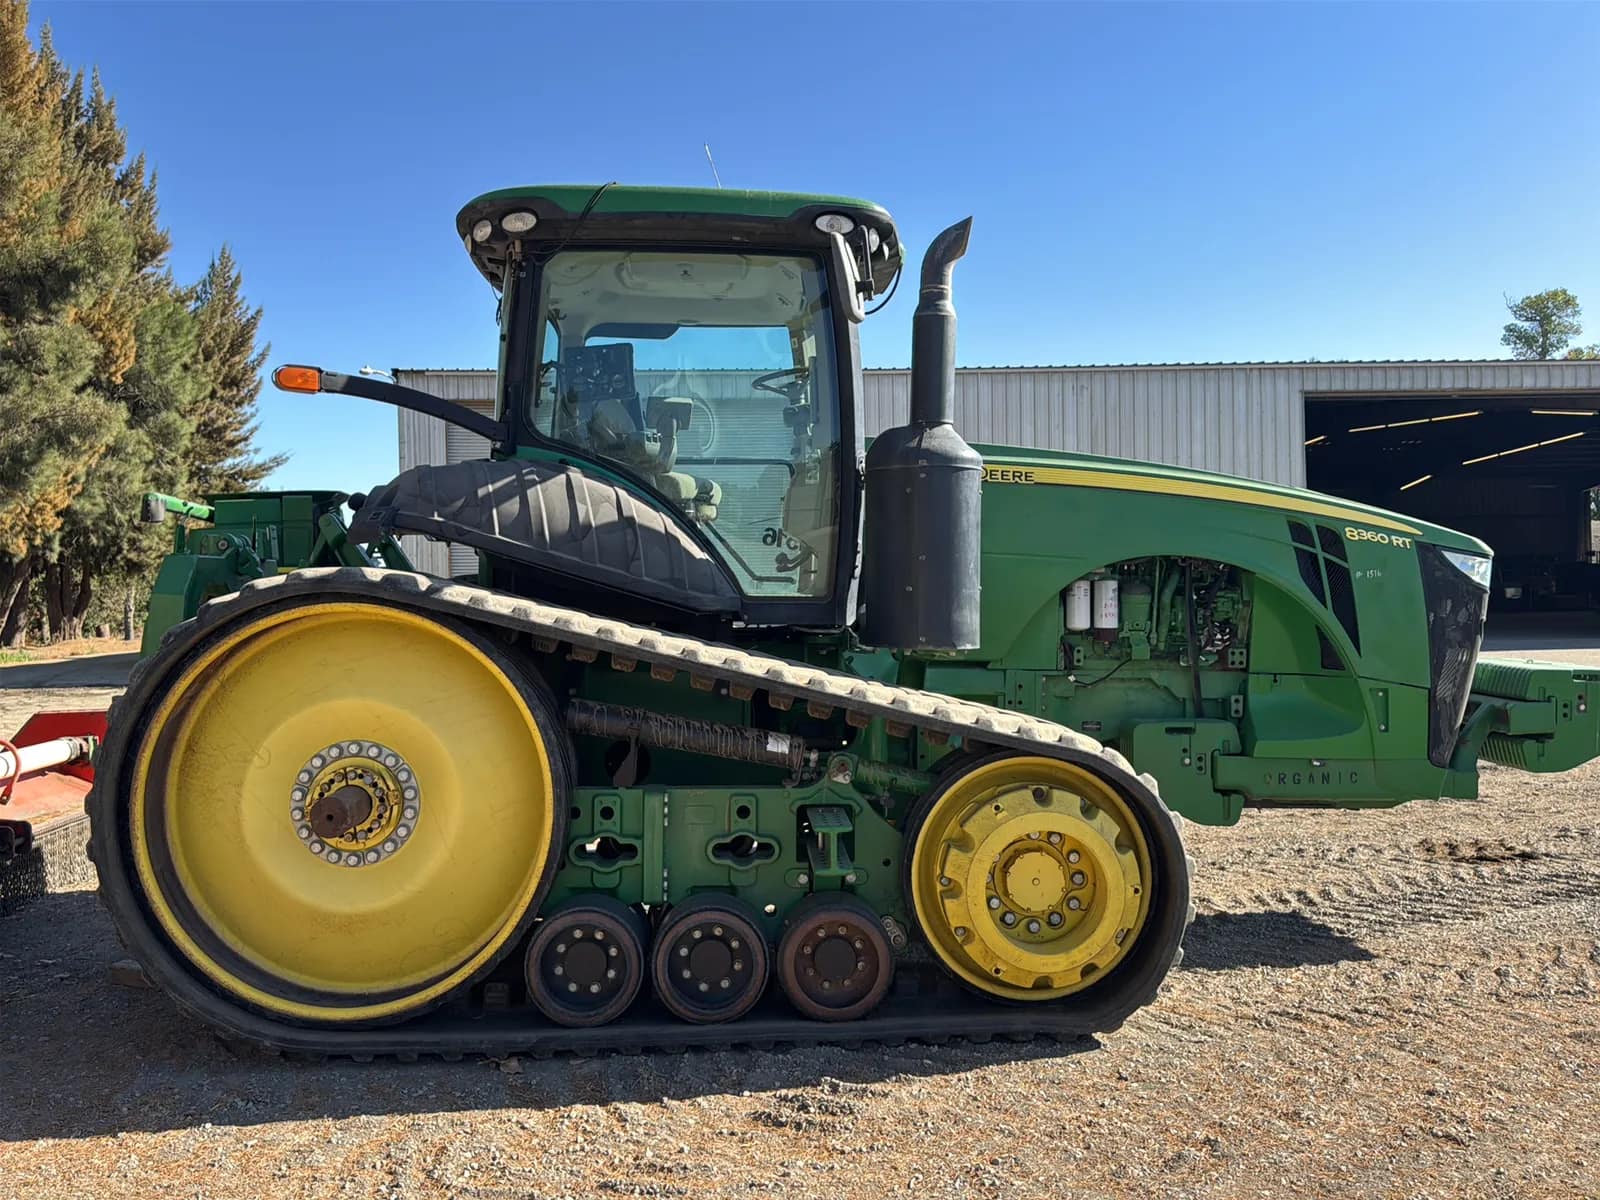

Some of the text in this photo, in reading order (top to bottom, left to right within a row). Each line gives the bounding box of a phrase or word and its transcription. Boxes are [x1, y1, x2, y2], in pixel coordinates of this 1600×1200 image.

[1344, 526, 1412, 549] 8360 RT
[1264, 771, 1358, 785] ORGANIC
